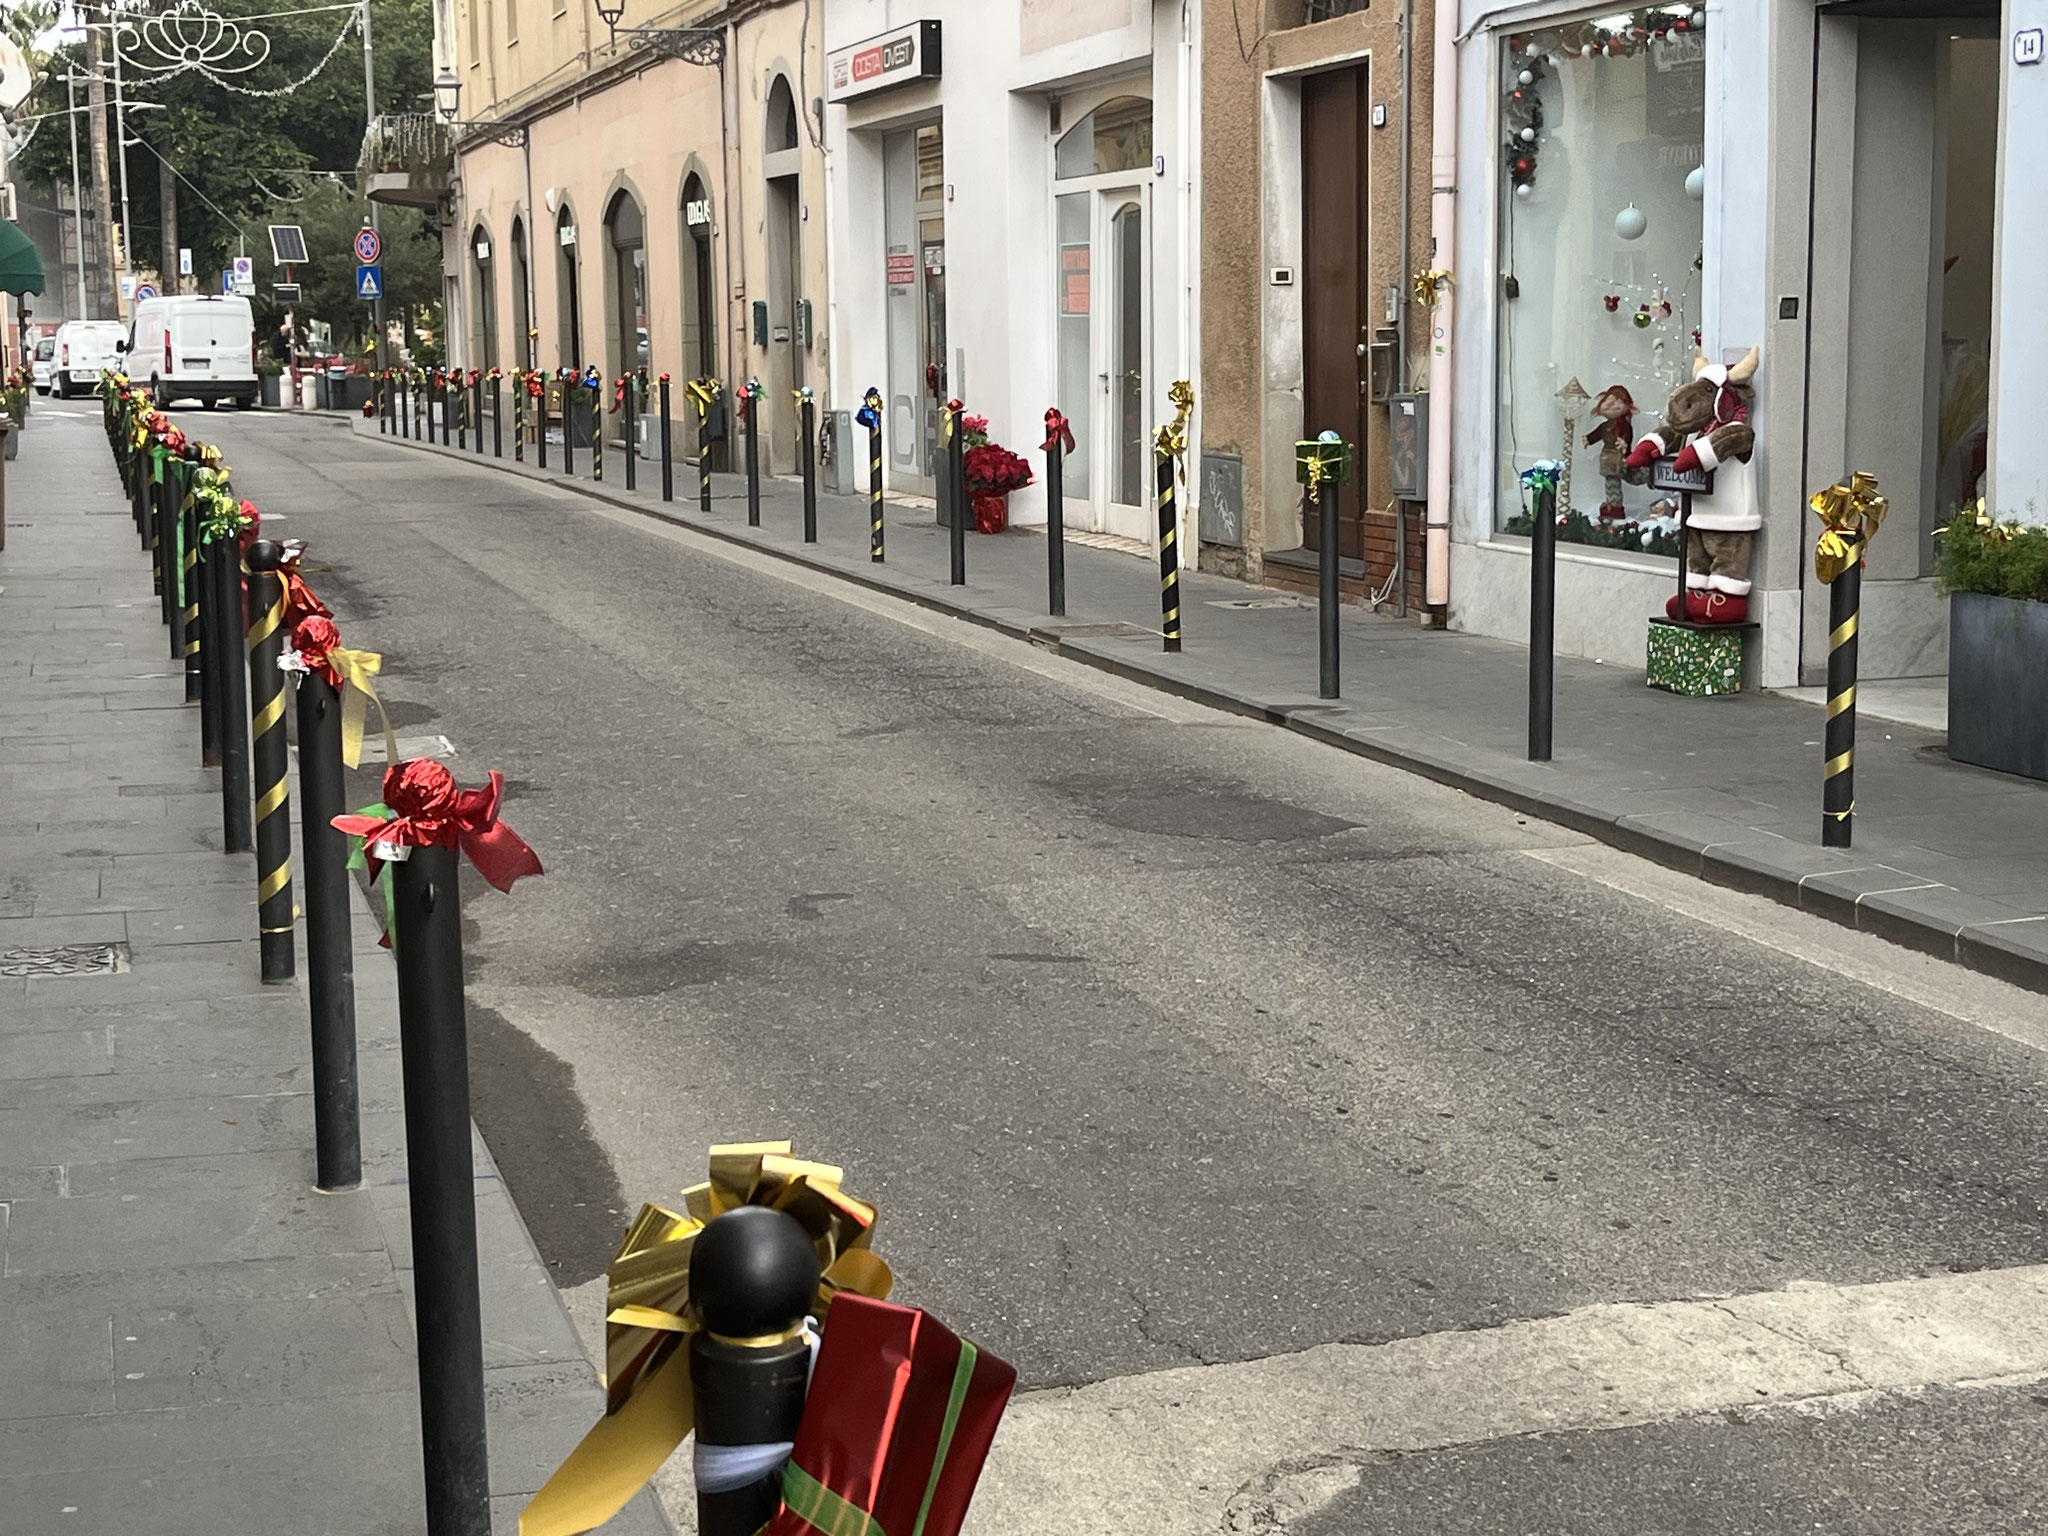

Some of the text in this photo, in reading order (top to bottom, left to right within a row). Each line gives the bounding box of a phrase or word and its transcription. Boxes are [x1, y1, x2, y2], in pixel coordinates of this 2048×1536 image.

[2023, 38, 2034, 55] 14
[855, 52, 880, 77] COSTA
[883, 41, 911, 68] OVEST
[1656, 465, 1706, 484] WELCOME
